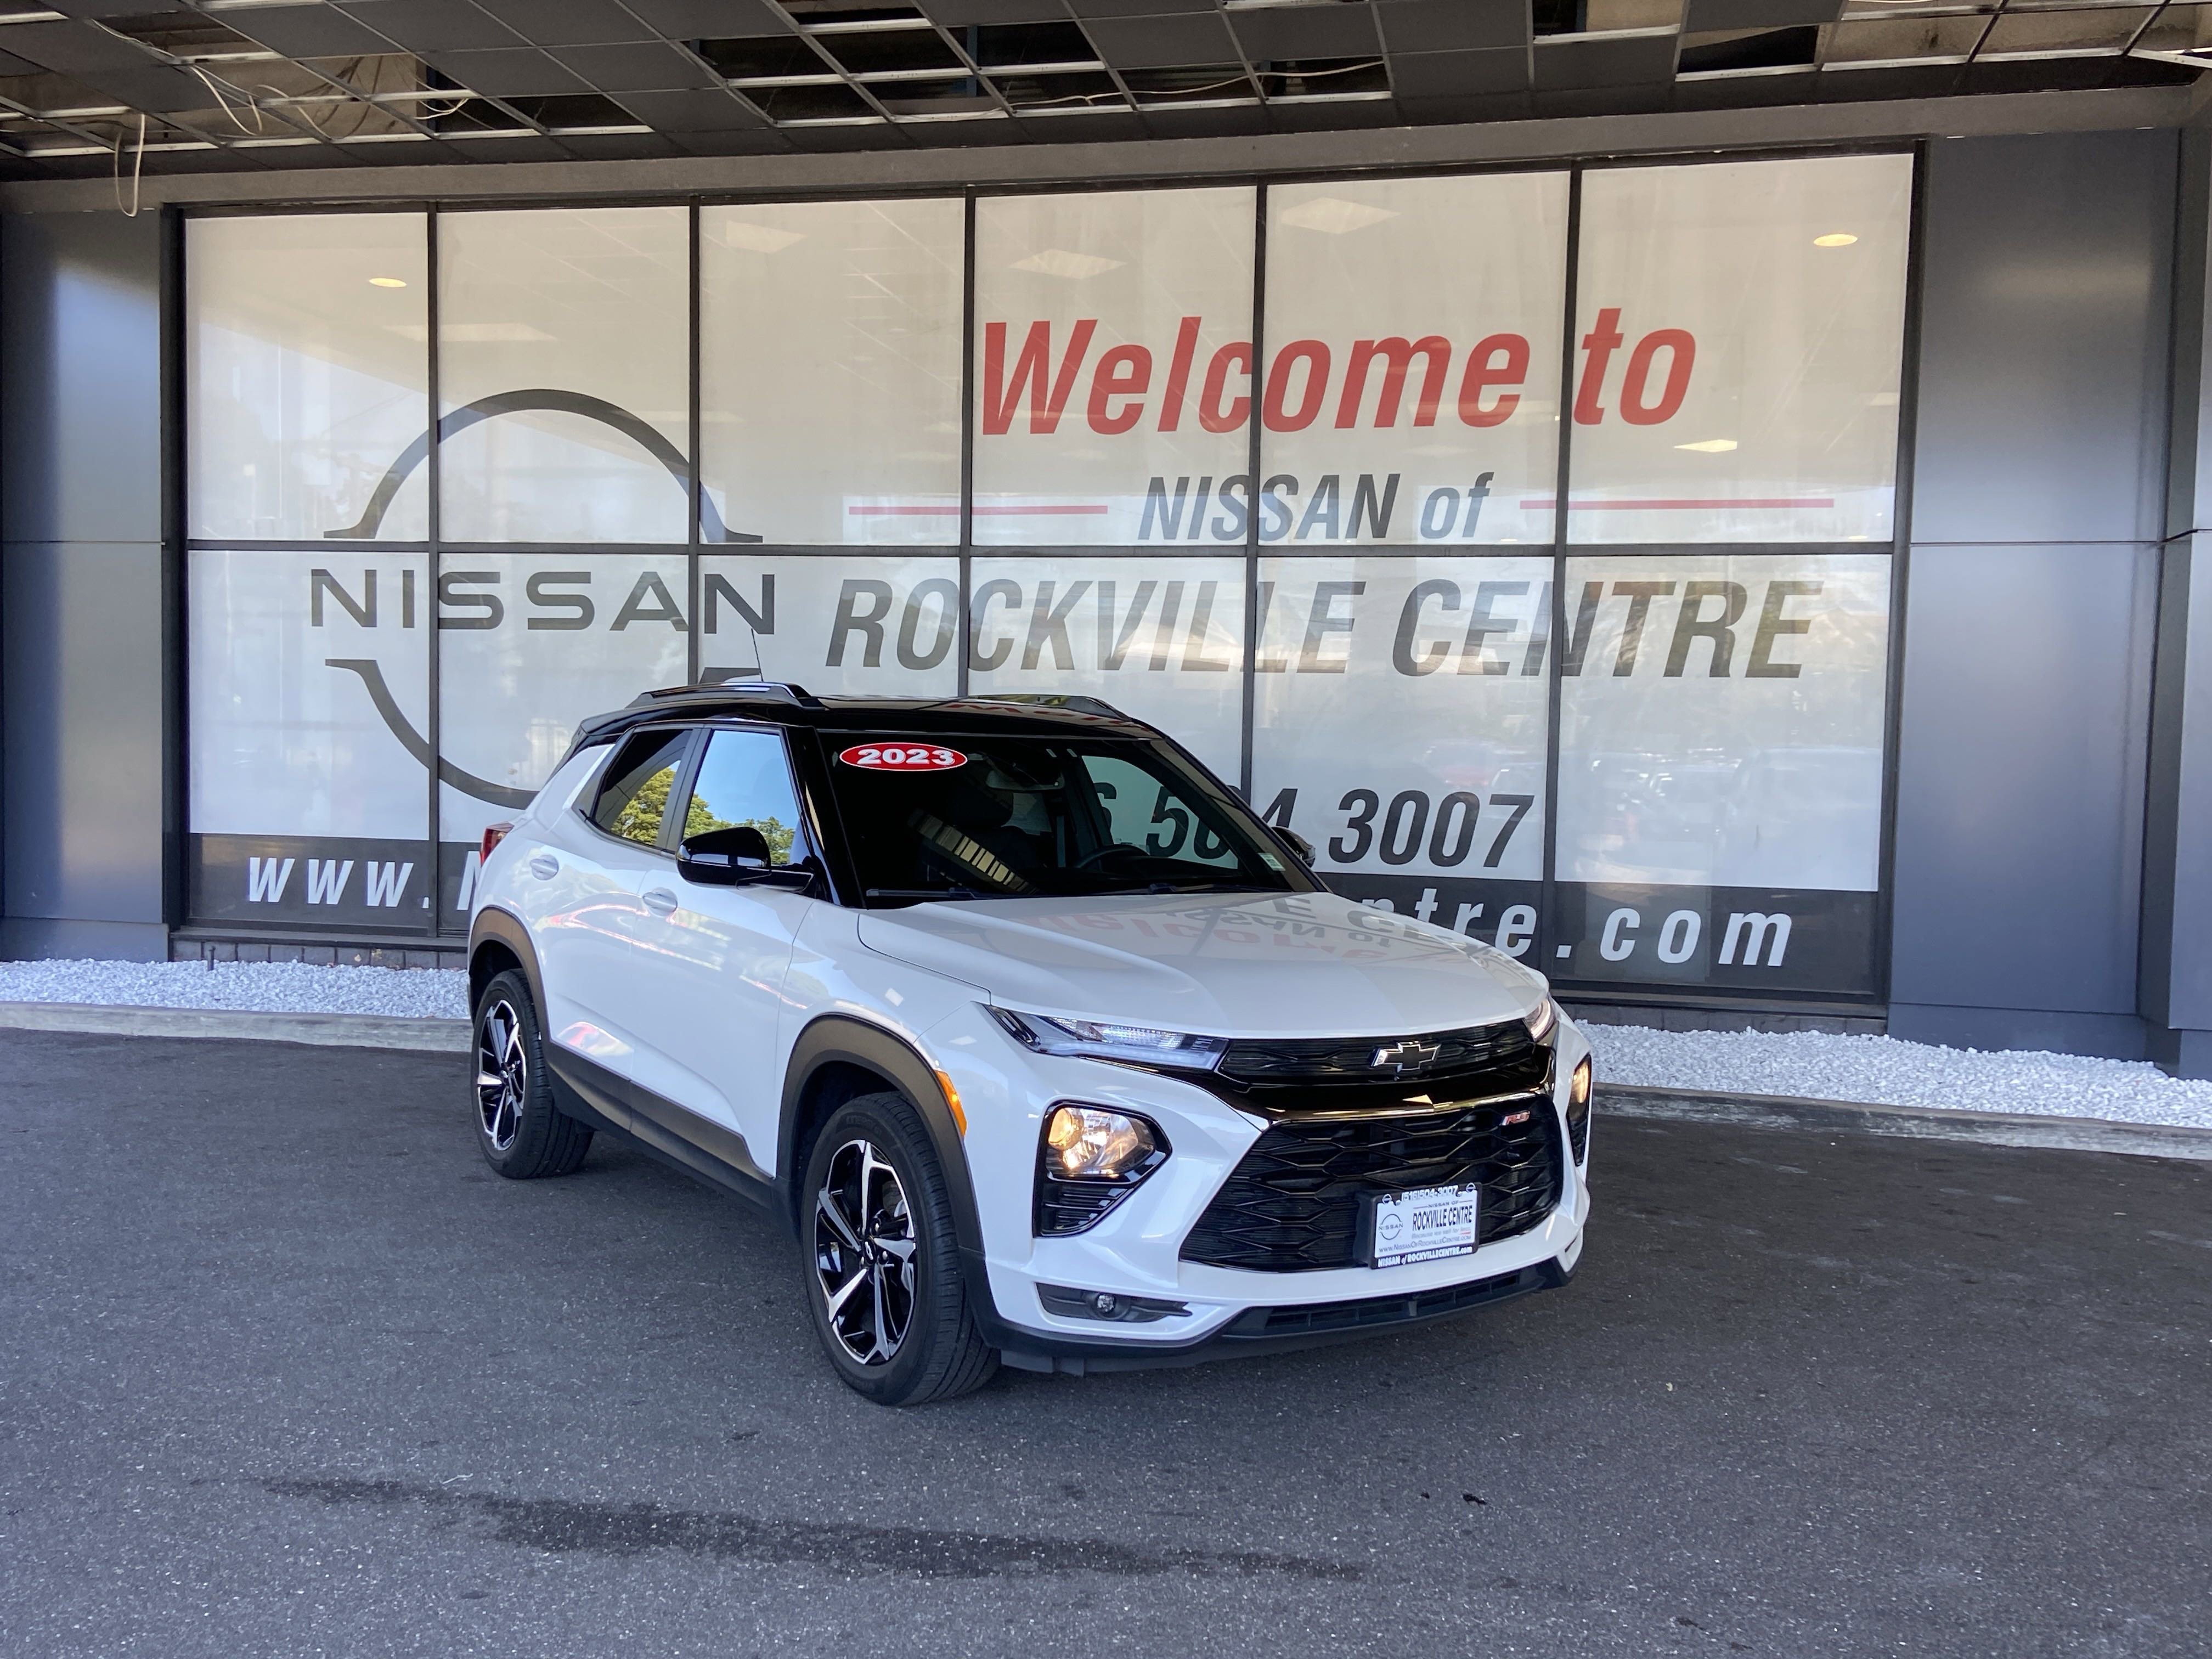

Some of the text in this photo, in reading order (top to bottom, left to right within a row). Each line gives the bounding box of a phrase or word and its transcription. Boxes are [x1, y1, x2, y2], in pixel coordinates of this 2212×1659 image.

[982, 308, 1696, 435] Welcome to
[1138, 471, 1494, 541] NISSAN of
[311, 568, 775, 635] NISSAN
[825, 577, 1824, 678] ROCKVILLE CENTRE
[856, 748, 956, 766] 2023
[1328, 788, 1535, 868] 3007
[1413, 1205, 1472, 1231] ROCKVILLE CENTRE
